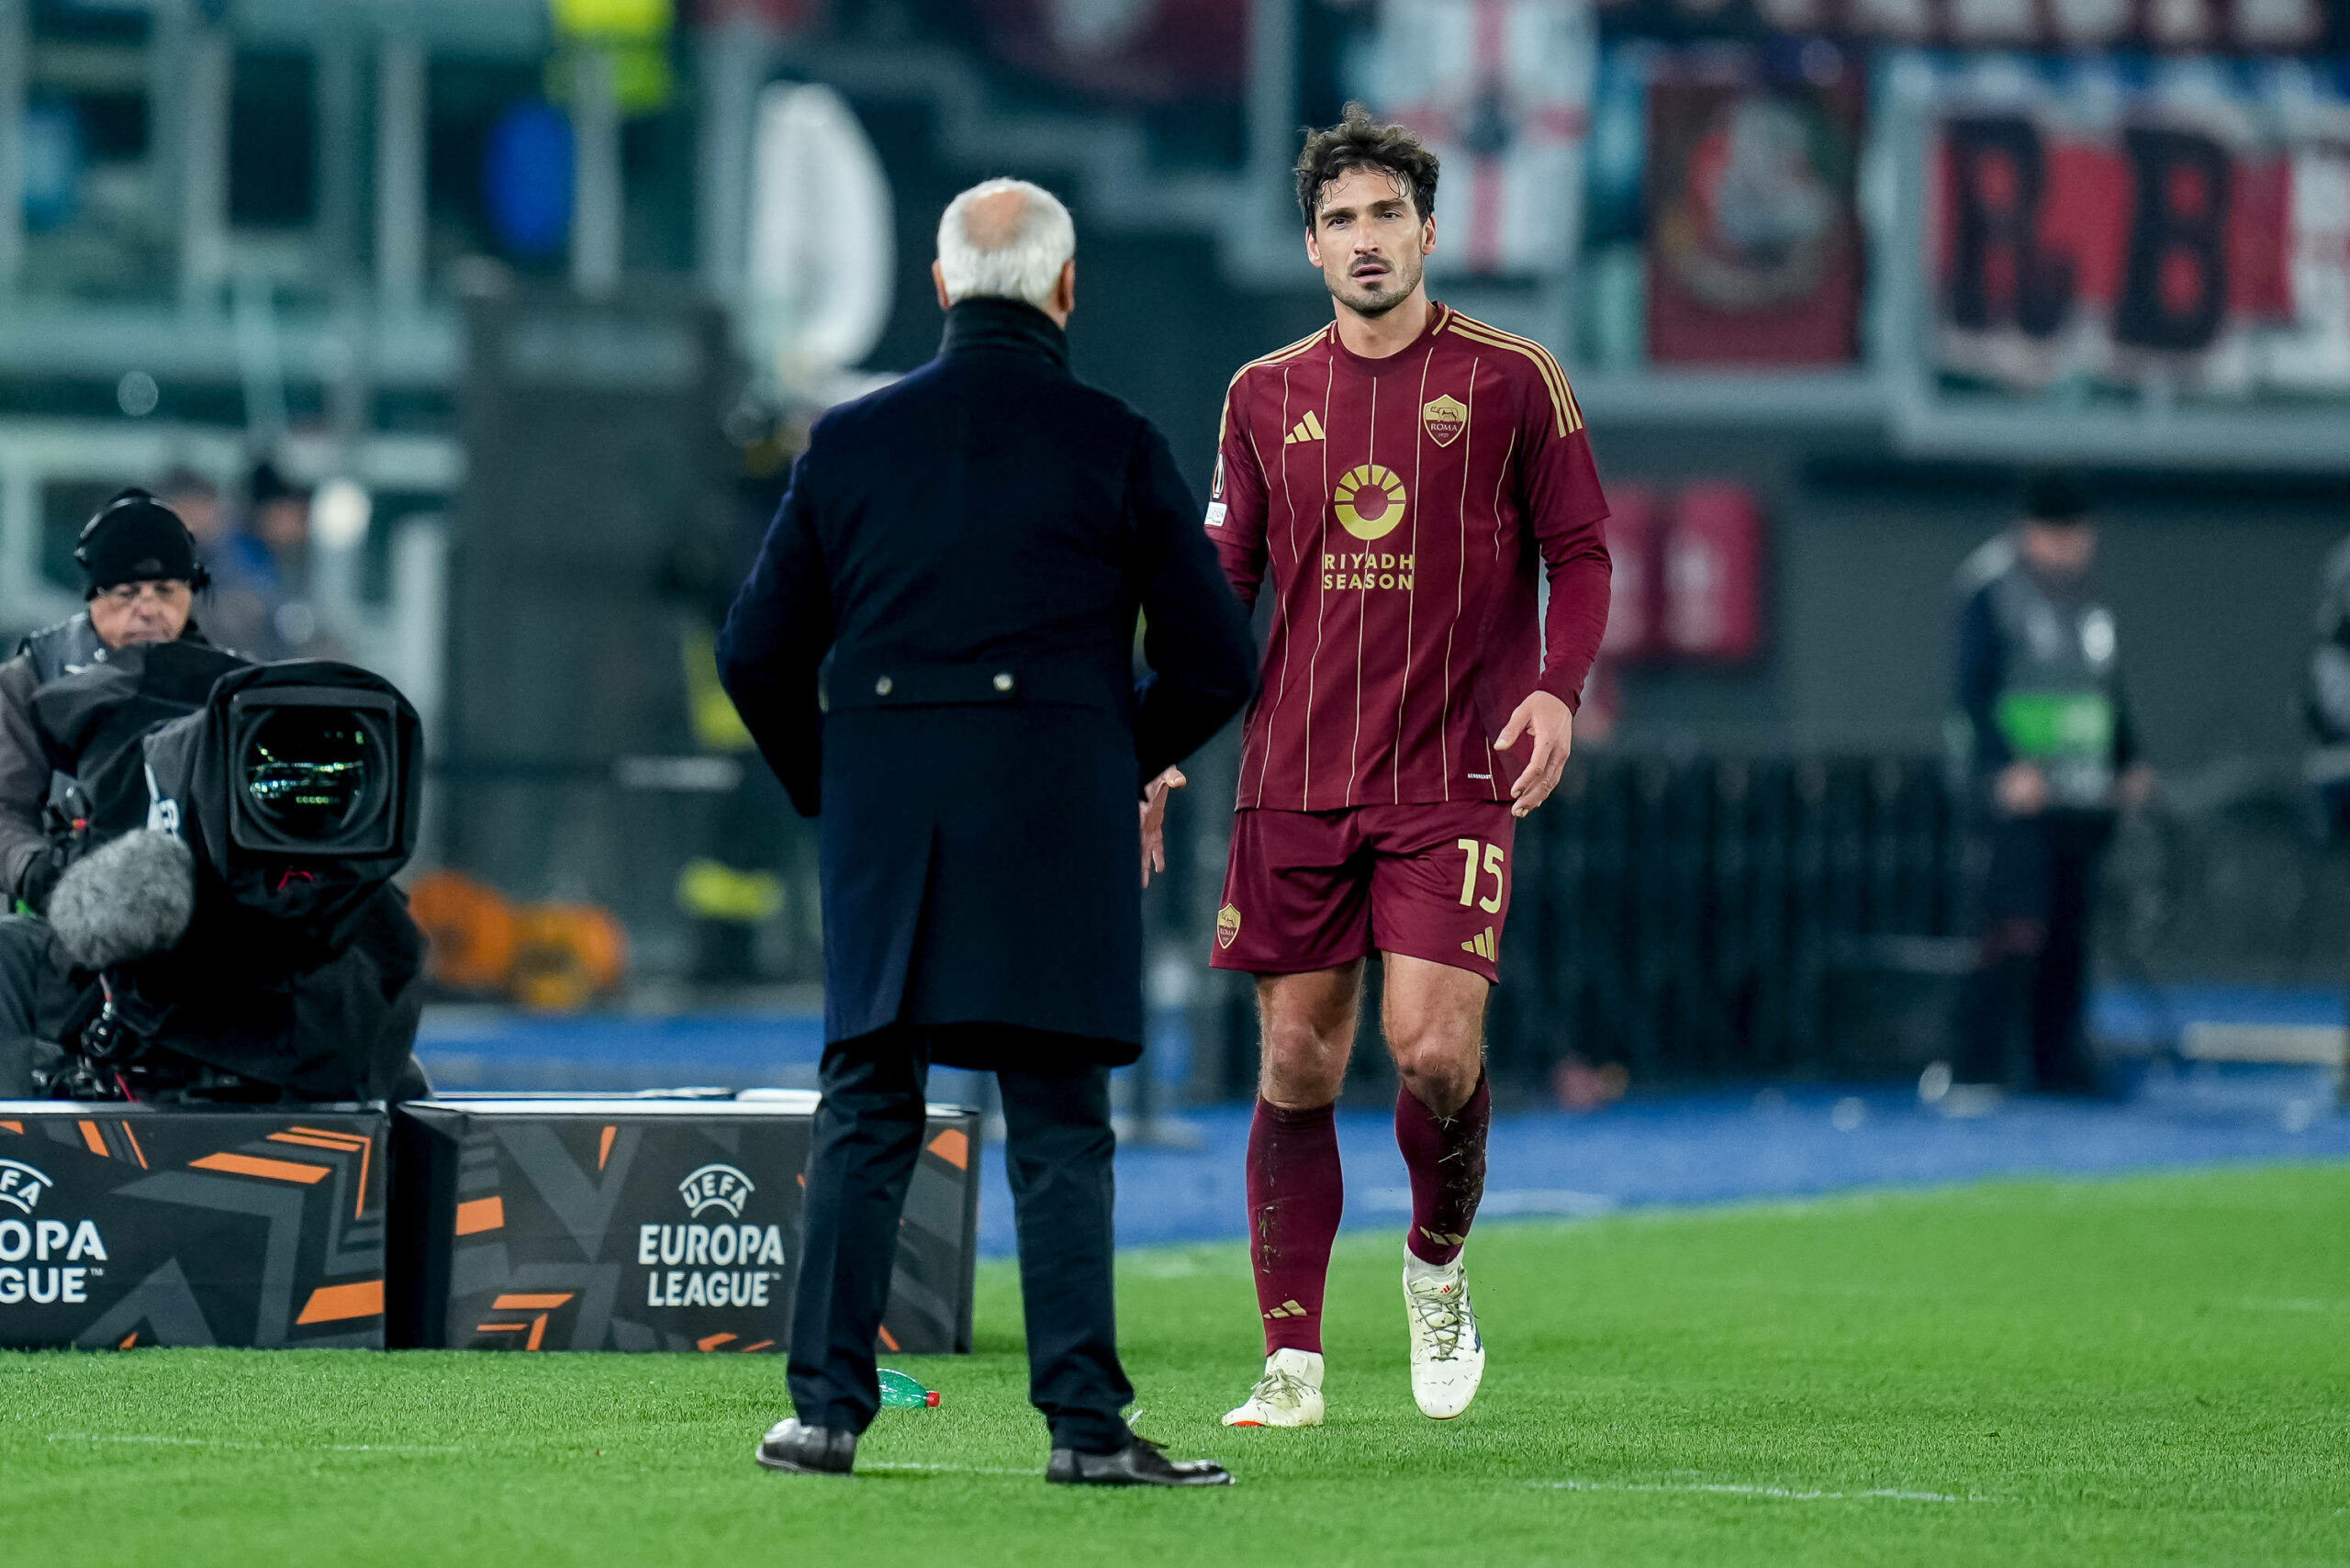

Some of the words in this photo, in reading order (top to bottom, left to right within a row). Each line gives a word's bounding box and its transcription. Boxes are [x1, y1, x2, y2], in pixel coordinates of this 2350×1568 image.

[1430, 422, 1458, 432] ROMA
[1324, 553, 1414, 570] RIYADH
[1323, 573, 1414, 590] SEASON
[1458, 838, 1505, 914] 15
[682, 1172, 748, 1212] UEFA
[638, 1224, 785, 1266] EUROPA
[647, 1271, 770, 1307] LEAGUE
